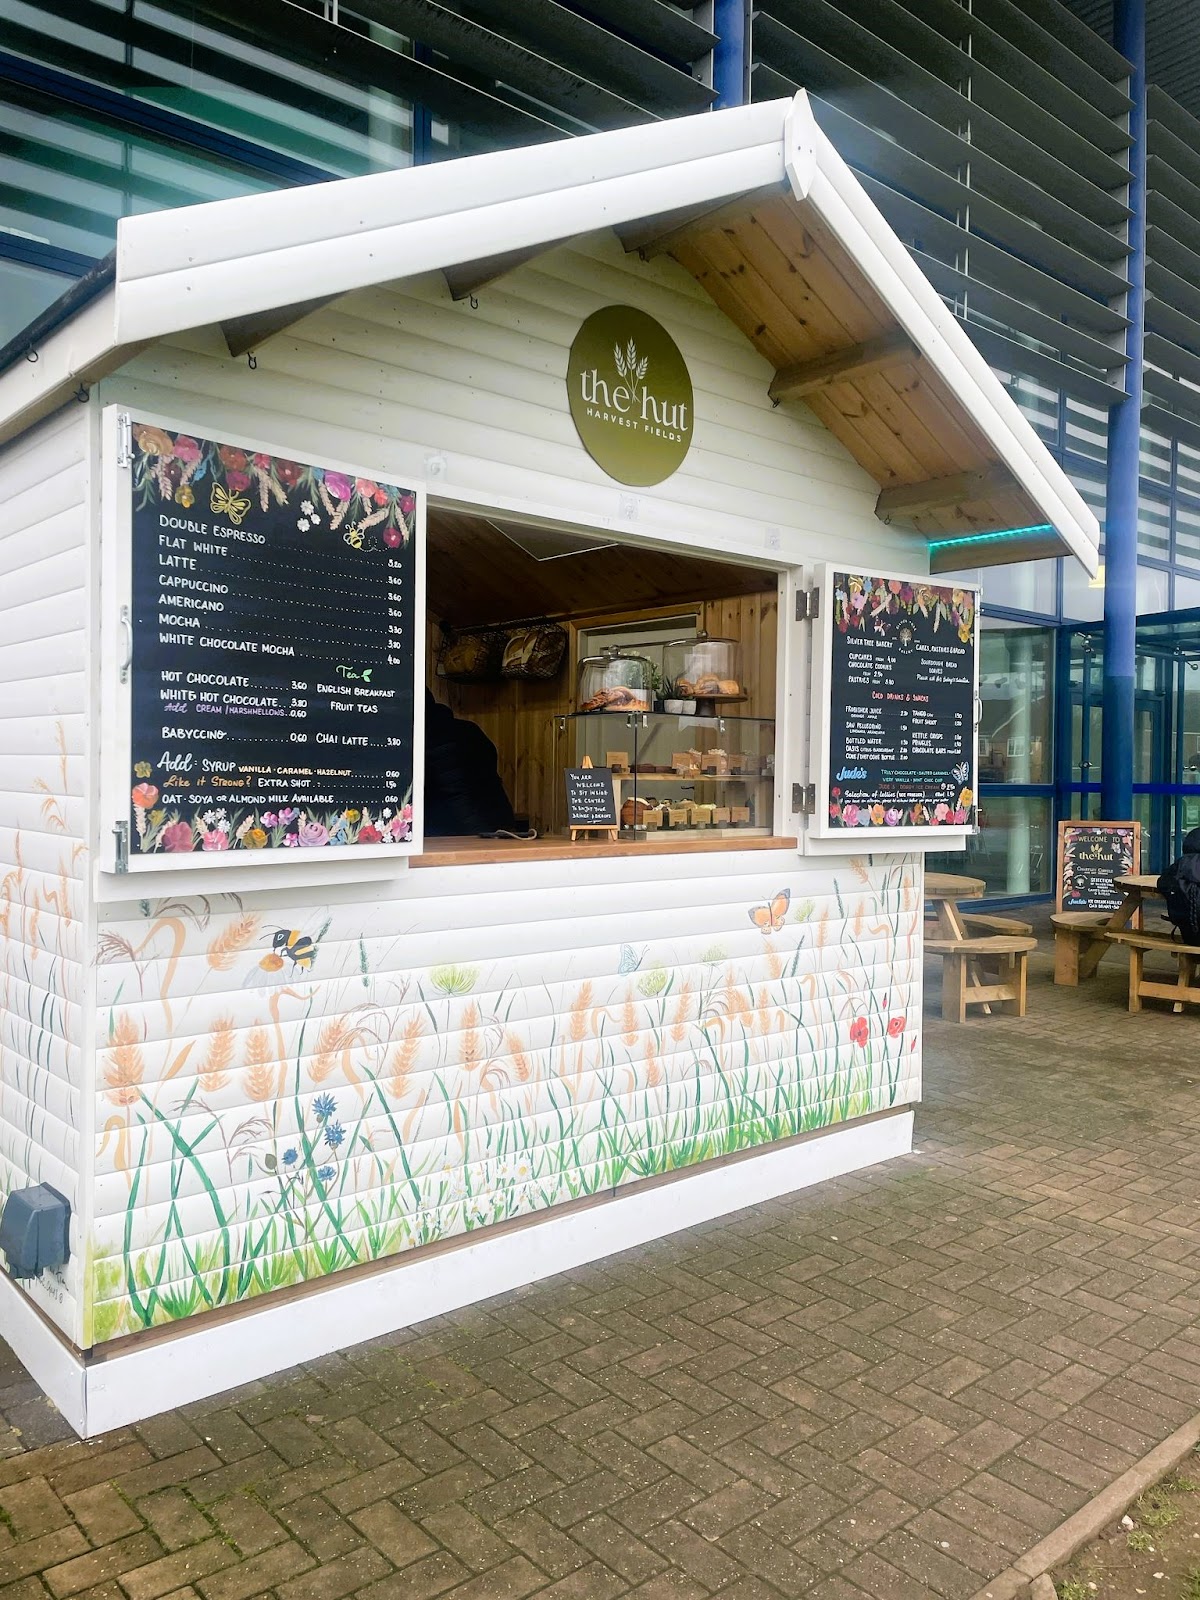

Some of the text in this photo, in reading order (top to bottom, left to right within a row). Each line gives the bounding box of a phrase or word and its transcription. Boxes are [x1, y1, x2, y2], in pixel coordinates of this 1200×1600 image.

[580, 368, 689, 432] the hut
[586, 407, 682, 443] HARVEST FIELDS
[159, 514, 208, 535] DOUBLE
[213, 525, 266, 545] ESPRESSO
[159, 534, 187, 550] FLAT
[193, 541, 228, 557] WHITE
[159, 553, 197, 571] LATTE
[158, 574, 229, 594] CAPPUCCINO
[158, 593, 224, 612] AMERICANO
[158, 613, 201, 628] MOCHA
[159, 632, 195, 646] WHITE
[199, 636, 258, 653] CHOCOLATE
[261, 643, 295, 657] MOCHA
[161, 670, 183, 682] HOT
[186, 672, 250, 688] CHOCOLATE
[335, 664, 360, 679] Tea
[160, 688, 197, 702] WHITE
[199, 691, 220, 703] HOT
[222, 693, 279, 707] CHOCOLATE
[316, 683, 396, 698] ENGLISH BREAKFAST
[886, 692, 904, 701] DRINKS
[164, 702, 188, 714] Add
[195, 703, 222, 714] CREAM
[330, 701, 378, 714] FRUIT TEAS
[161, 726, 228, 740] BABYCCINO
[315, 732, 338, 744] CHAI
[342, 735, 369, 747] LATTE
[201, 758, 236, 773] SYRUP
[836, 766, 868, 781] Jude's
[163, 774, 191, 788] Like
[196, 775, 207, 787] it
[257, 777, 289, 788] EXTRA
[290, 779, 311, 789] SHOT
[162, 794, 183, 804] OAT
[188, 794, 214, 804] SOYA
[228, 793, 267, 804] ALMOND
[268, 794, 289, 803] MILK
[291, 793, 334, 804] AVAILABLE
[1078, 835, 1108, 843] WELCOME
[1079, 851, 1114, 861] the hut
